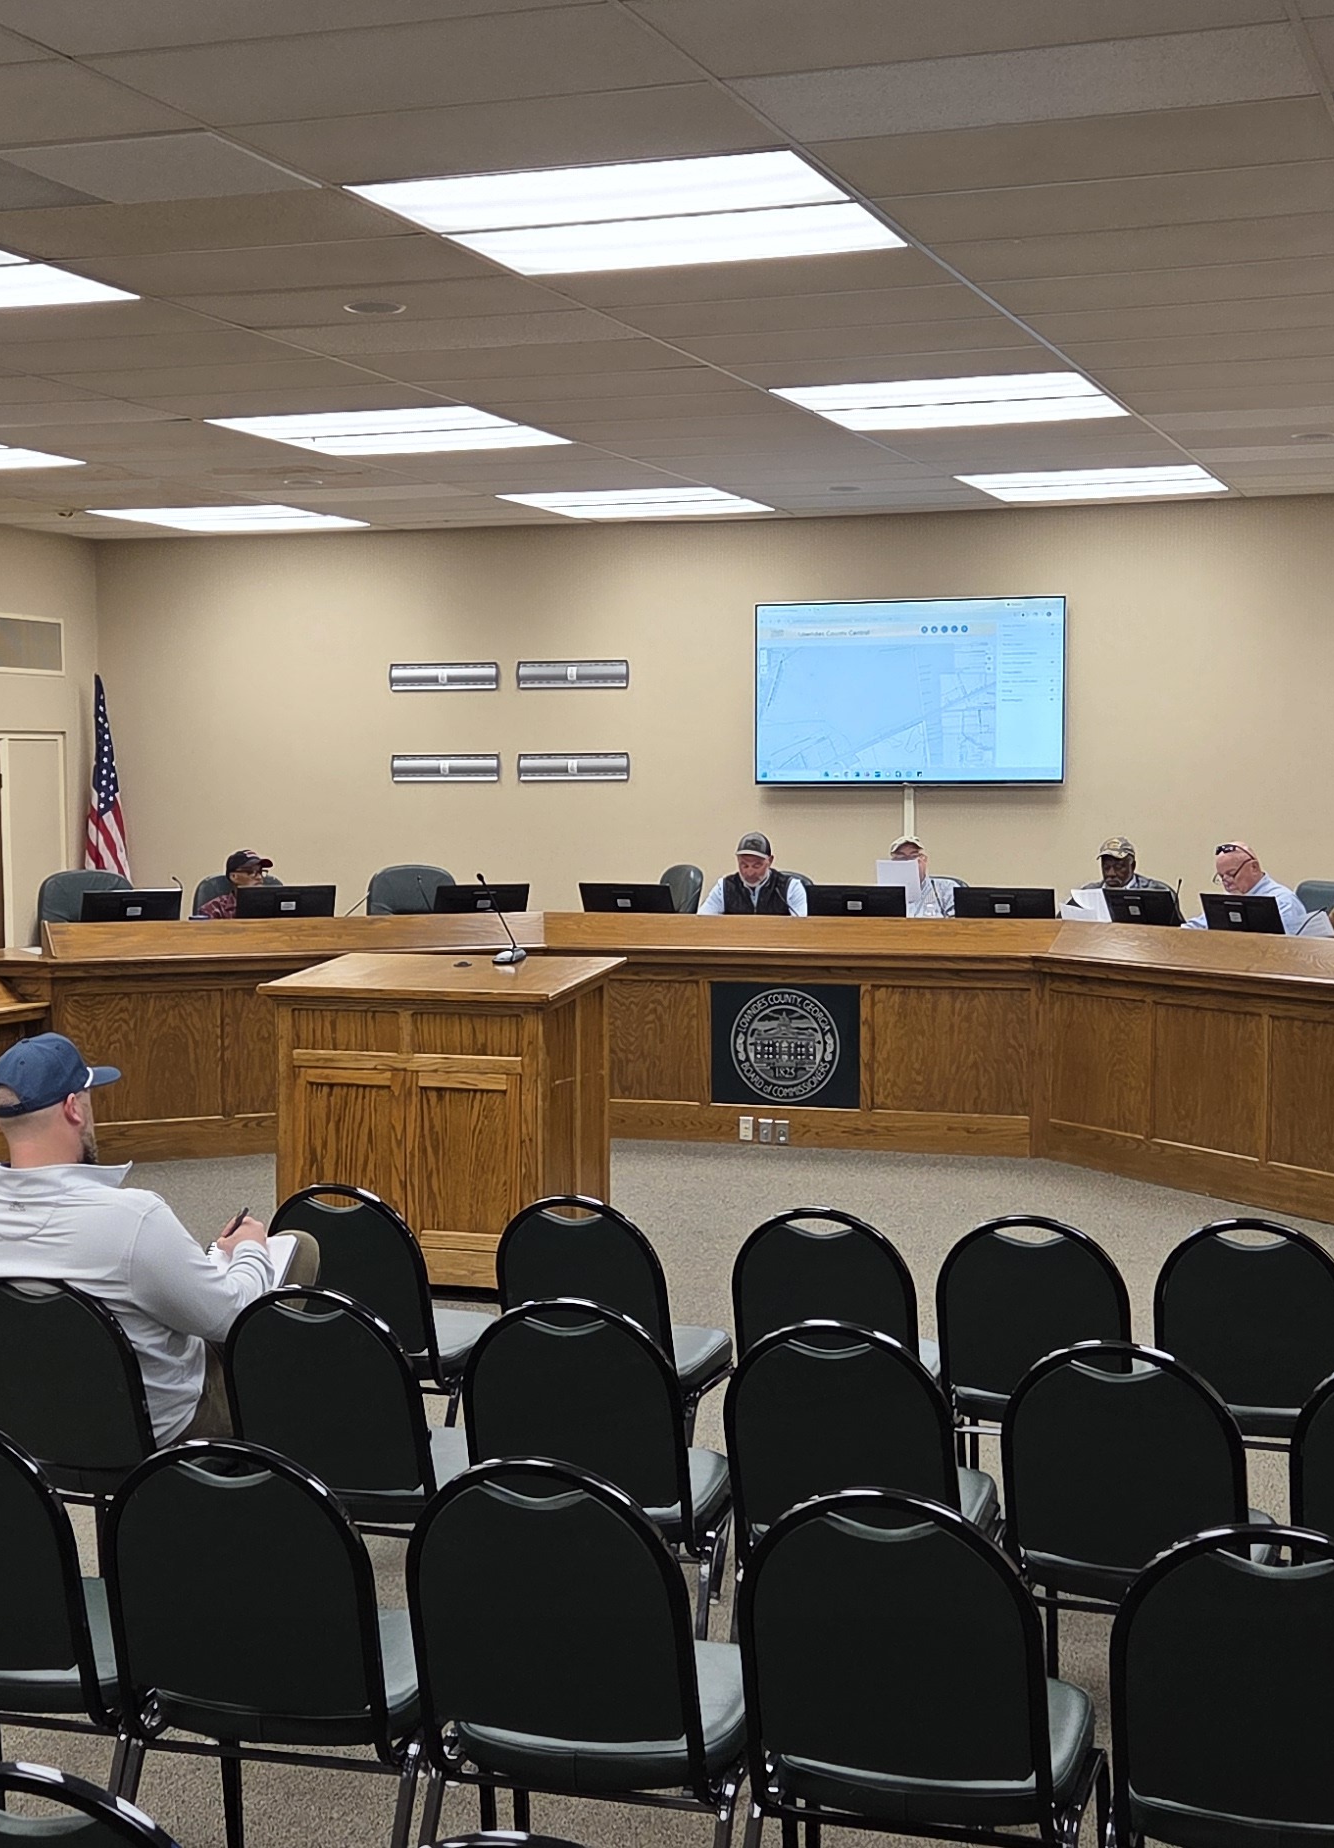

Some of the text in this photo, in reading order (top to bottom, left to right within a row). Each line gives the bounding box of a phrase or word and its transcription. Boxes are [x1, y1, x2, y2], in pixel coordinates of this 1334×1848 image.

[738, 997, 768, 1032] LOWNDES
[802, 1000, 831, 1032] GEORGIA
[740, 1062, 764, 1088] BOARD
[771, 1062, 830, 1097] COMMISSIONERS
[775, 1067, 795, 1078] 1825
